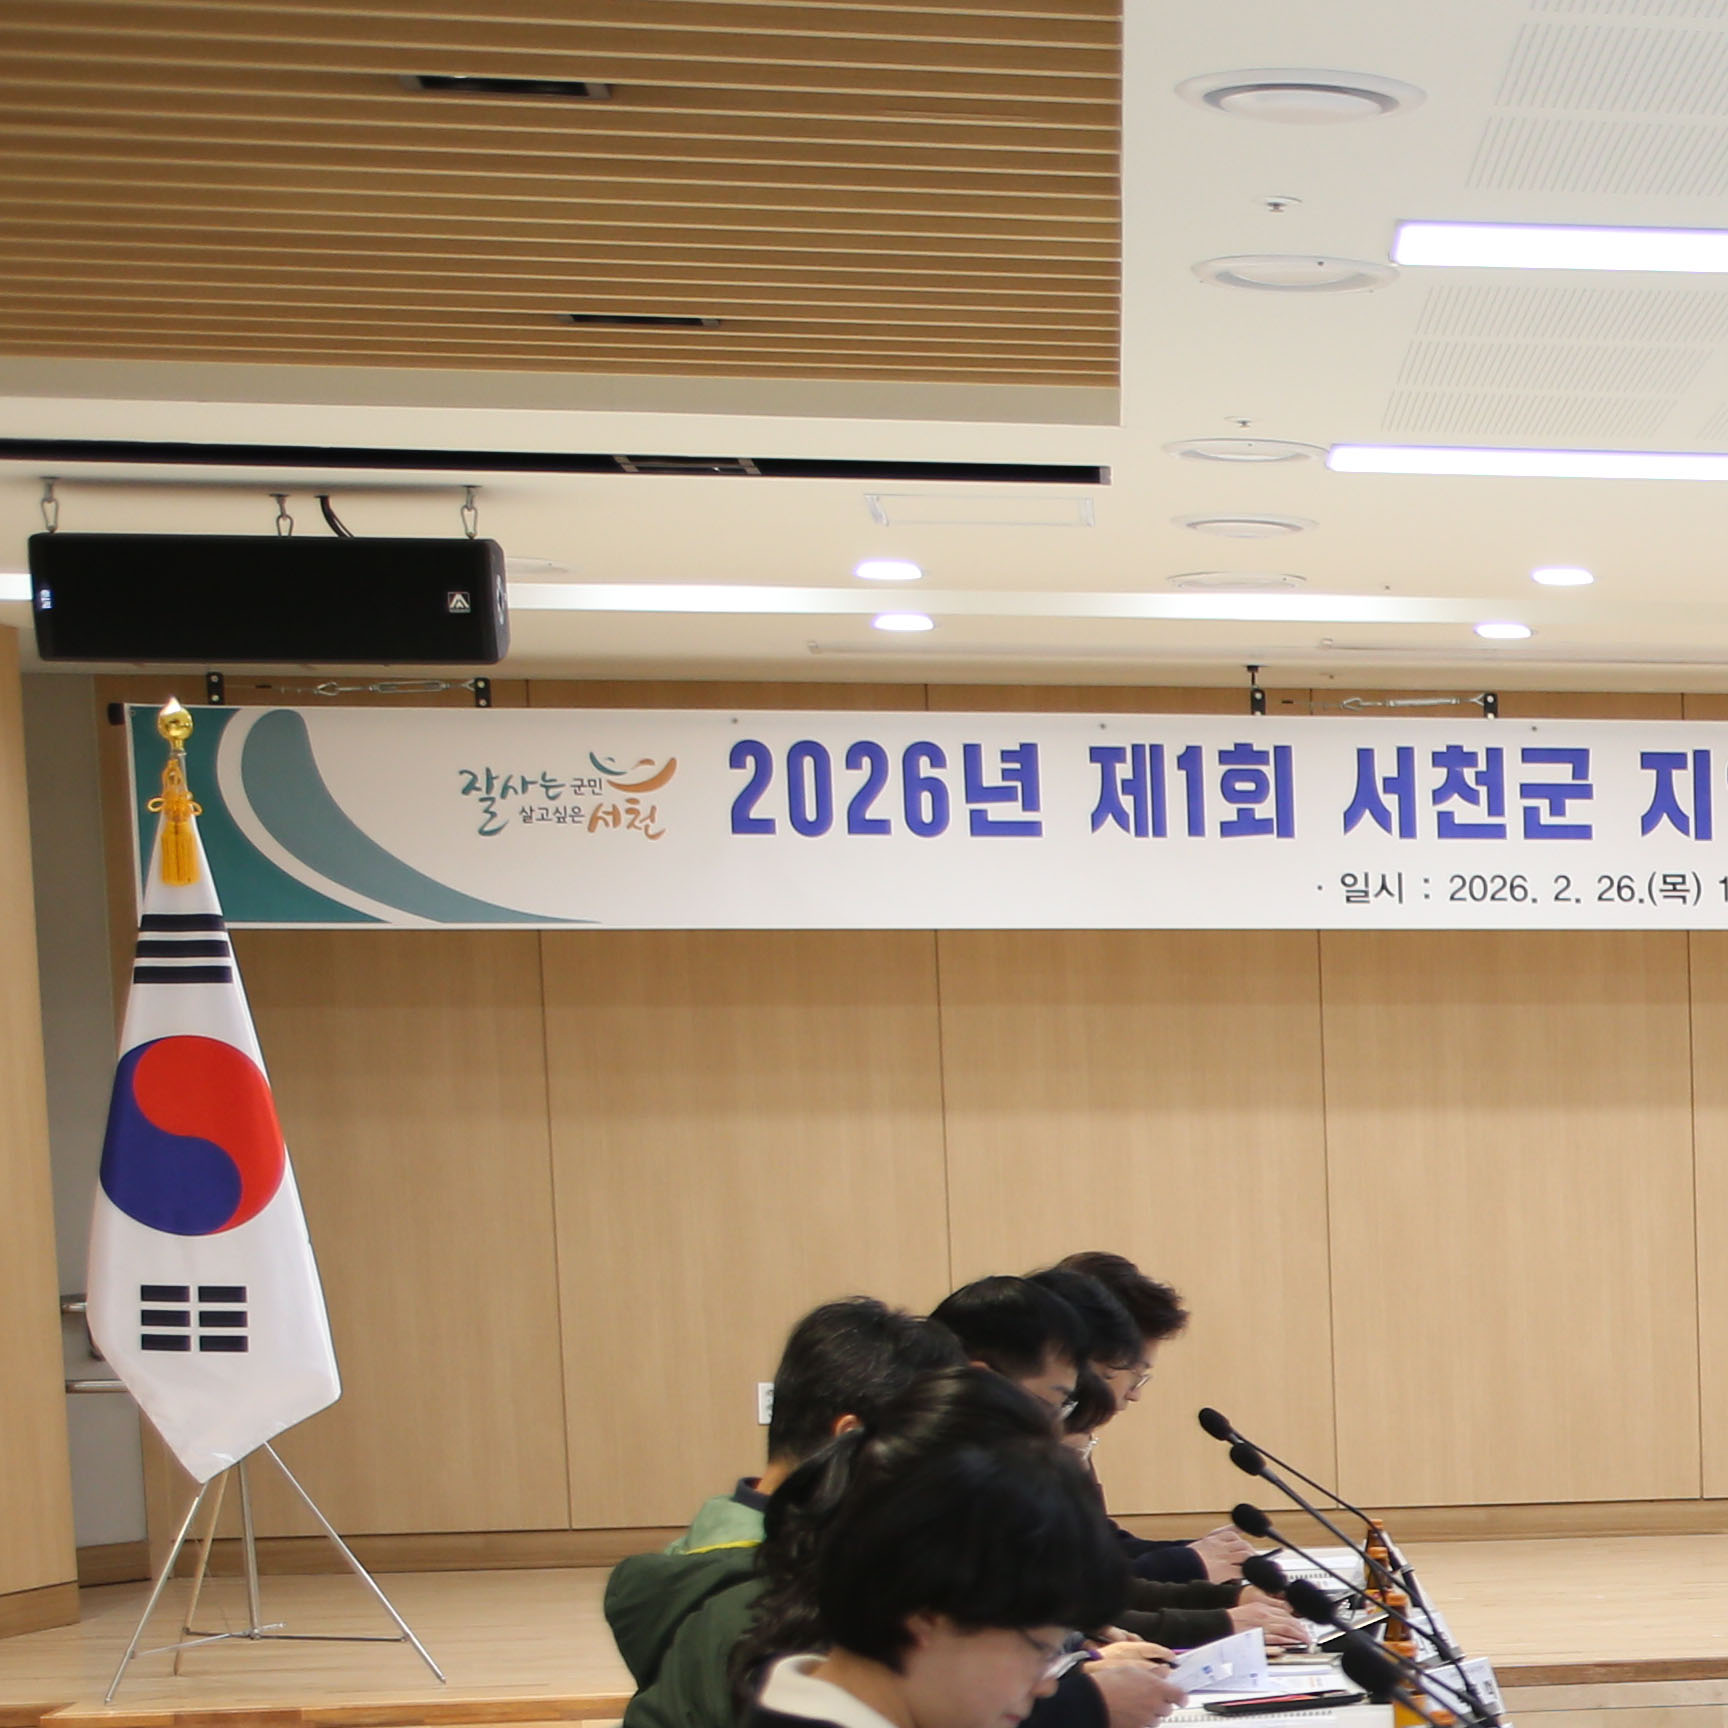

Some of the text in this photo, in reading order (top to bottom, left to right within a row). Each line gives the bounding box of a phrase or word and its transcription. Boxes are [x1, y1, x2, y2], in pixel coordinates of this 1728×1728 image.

[458, 766, 603, 837] 잘사는 군민
[731, 740, 1042, 838] 2026년
[1090, 743, 1295, 839] 제1회
[1344, 745, 1594, 840] 서천군
[519, 797, 666, 841] 살고싶은 서천
[1340, 872, 1403, 903] 일시
[1449, 873, 1537, 903] 2026.
[1553, 874, 1582, 903] 2.
